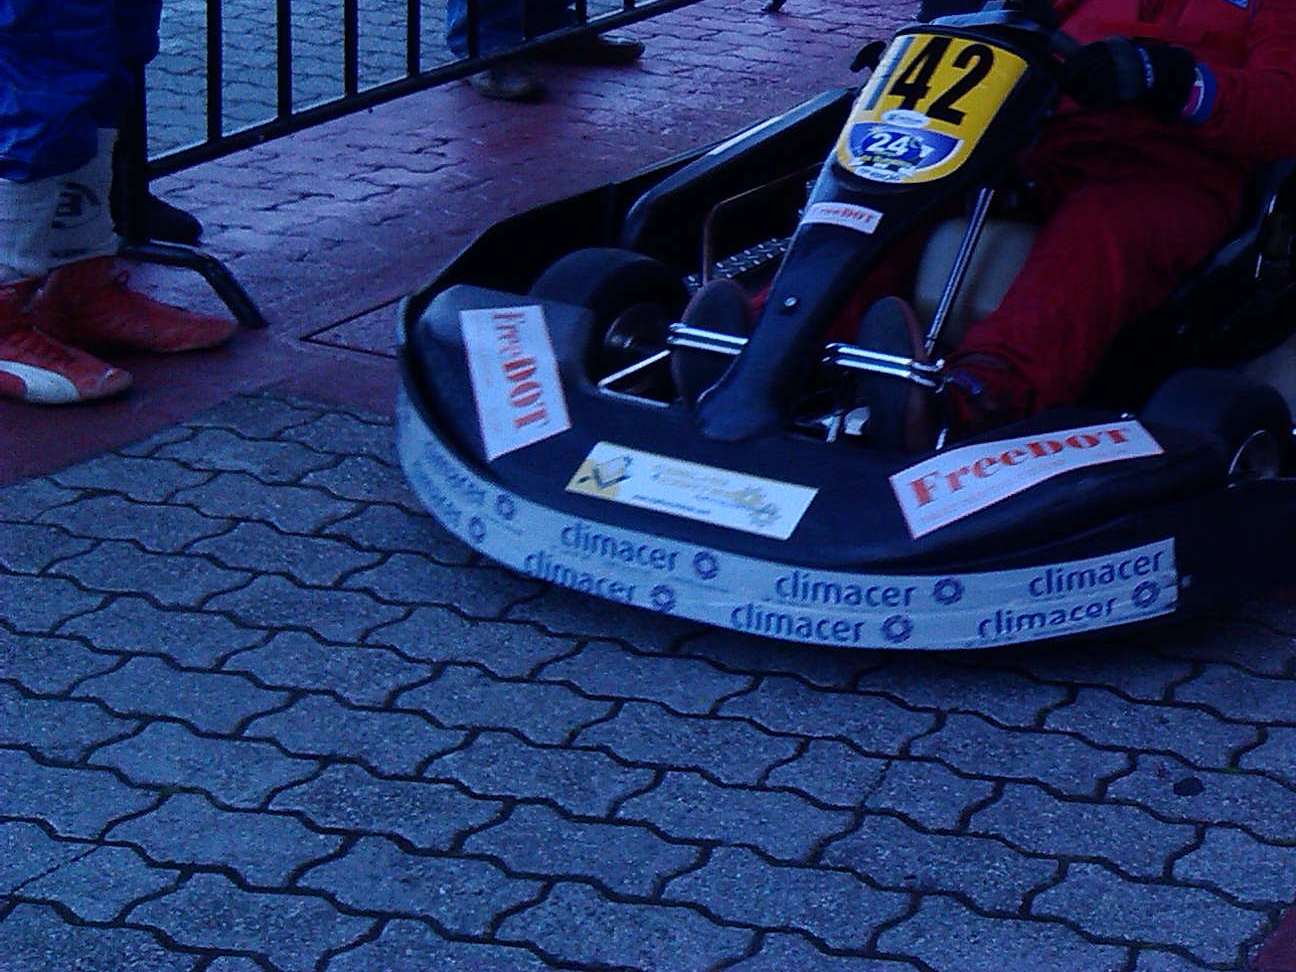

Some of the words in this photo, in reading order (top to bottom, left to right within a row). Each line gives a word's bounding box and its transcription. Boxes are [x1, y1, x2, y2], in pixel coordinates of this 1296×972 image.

[887, 36, 994, 125] 42
[865, 132, 912, 156] 24
[524, 549, 637, 605] climacer
[729, 603, 866, 642] climacer
[977, 596, 1118, 638] climacer
[560, 520, 680, 572] climacer
[774, 569, 917, 608] climacer
[1028, 550, 1165, 597] climacer
